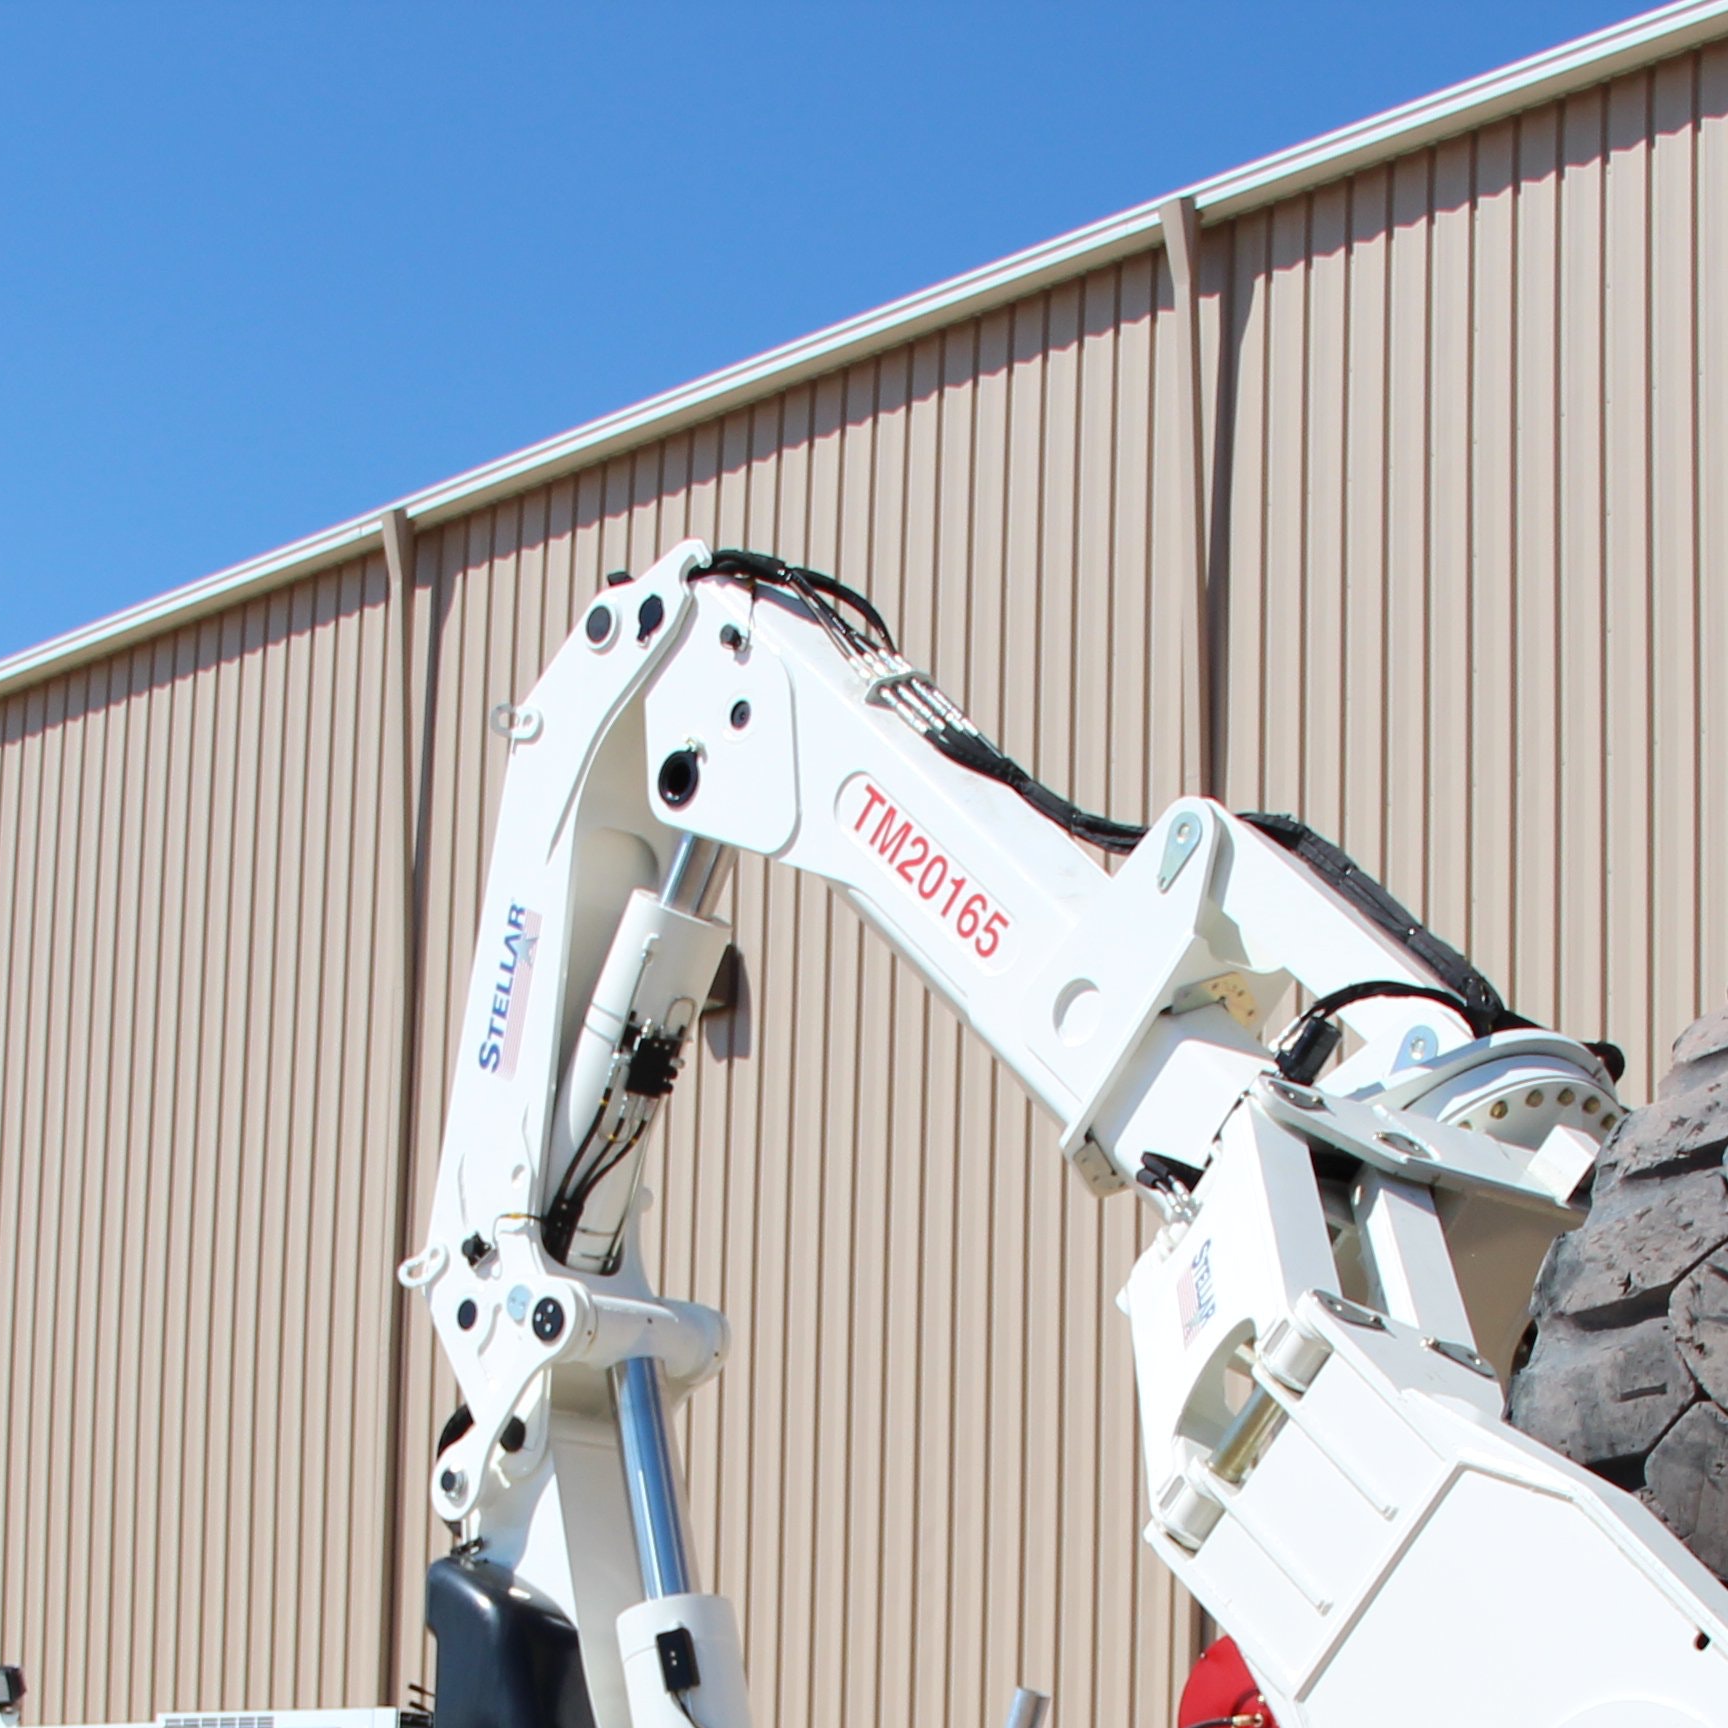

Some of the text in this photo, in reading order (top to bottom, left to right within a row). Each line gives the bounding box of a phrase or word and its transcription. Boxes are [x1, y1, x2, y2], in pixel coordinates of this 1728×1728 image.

[849, 783, 1010, 958] TM20165
[478, 903, 526, 1073] STELLAR
[1191, 1238, 1216, 1330] STELLAR
